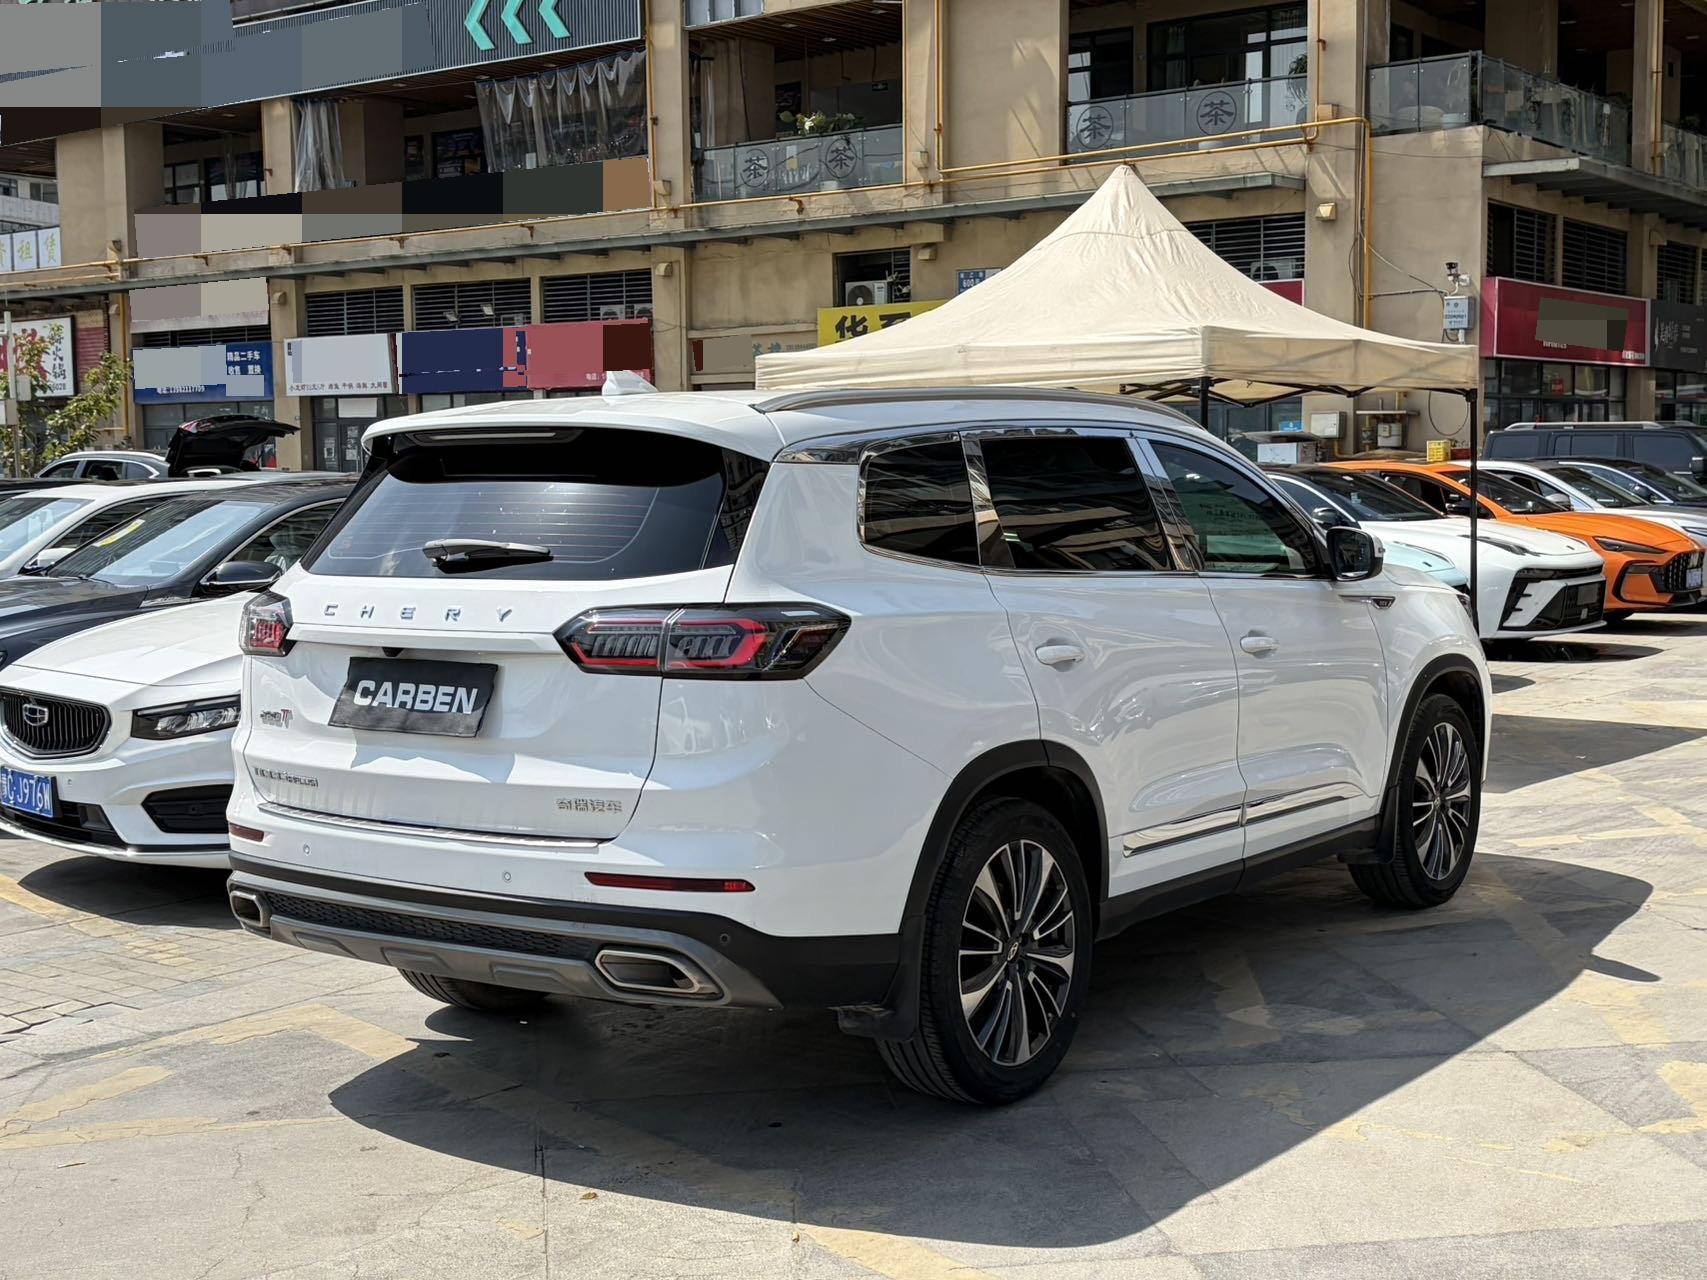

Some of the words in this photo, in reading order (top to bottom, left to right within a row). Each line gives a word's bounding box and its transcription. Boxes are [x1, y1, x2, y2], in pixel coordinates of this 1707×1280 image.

[1200, 100, 1234, 126] 茶
[1080, 115, 1111, 139] 茶
[742, 156, 768, 179] 茶
[828, 146, 855, 170] 茶
[323, 604, 513, 623] CHERY
[353, 679, 478, 715] CARBEN
